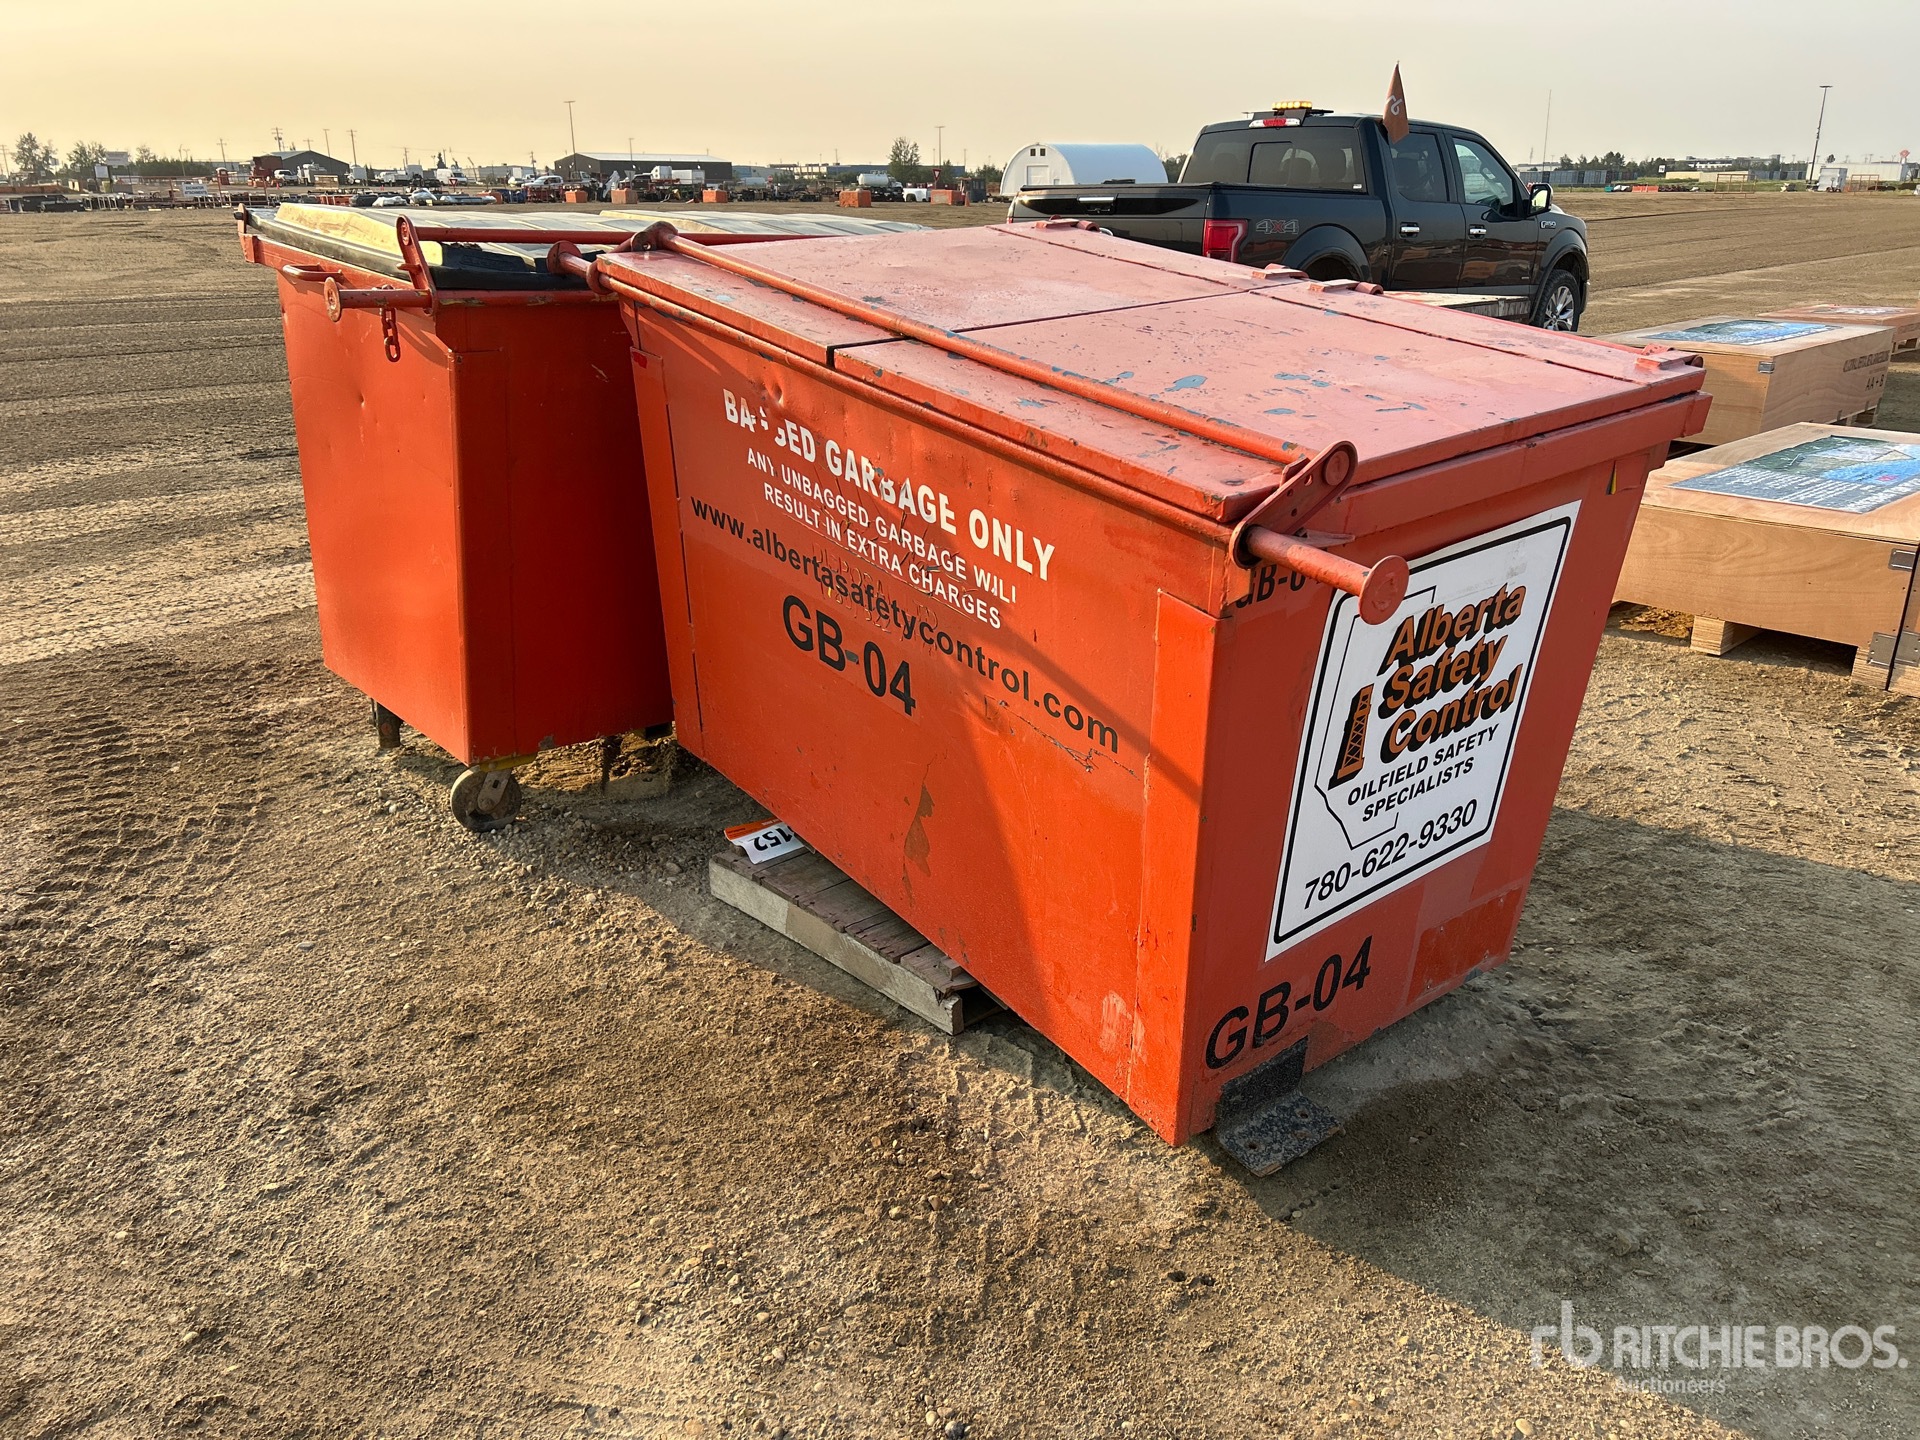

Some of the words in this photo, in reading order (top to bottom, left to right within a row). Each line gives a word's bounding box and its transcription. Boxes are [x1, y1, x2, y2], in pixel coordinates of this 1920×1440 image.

[747, 448, 776, 477] ANY
[781, 464, 870, 528] UNBAGGED
[875, 517, 968, 581] GARBAGE
[764, 482, 821, 529] RESULT
[825, 516, 842, 543] IN
[847, 529, 903, 577] EXTRA
[908, 563, 1001, 629] CHARGES
[826, 440, 957, 535] GARBAGE
[968, 509, 1056, 582] ONLY
[690, 496, 1119, 754] www.albertasafetycontrol.com
[782, 595, 918, 717] GB-04
[1376, 582, 1527, 677] Alberta
[1378, 634, 1509, 720] Safety
[1347, 755, 1429, 806] OILFIELD
[1432, 722, 1500, 766] SAFETY
[1380, 662, 1524, 764] Control
[1362, 756, 1475, 822] SPECIALISTS
[1303, 798, 1478, 910] 780-622-9330
[1205, 935, 1373, 1071] GB-04
